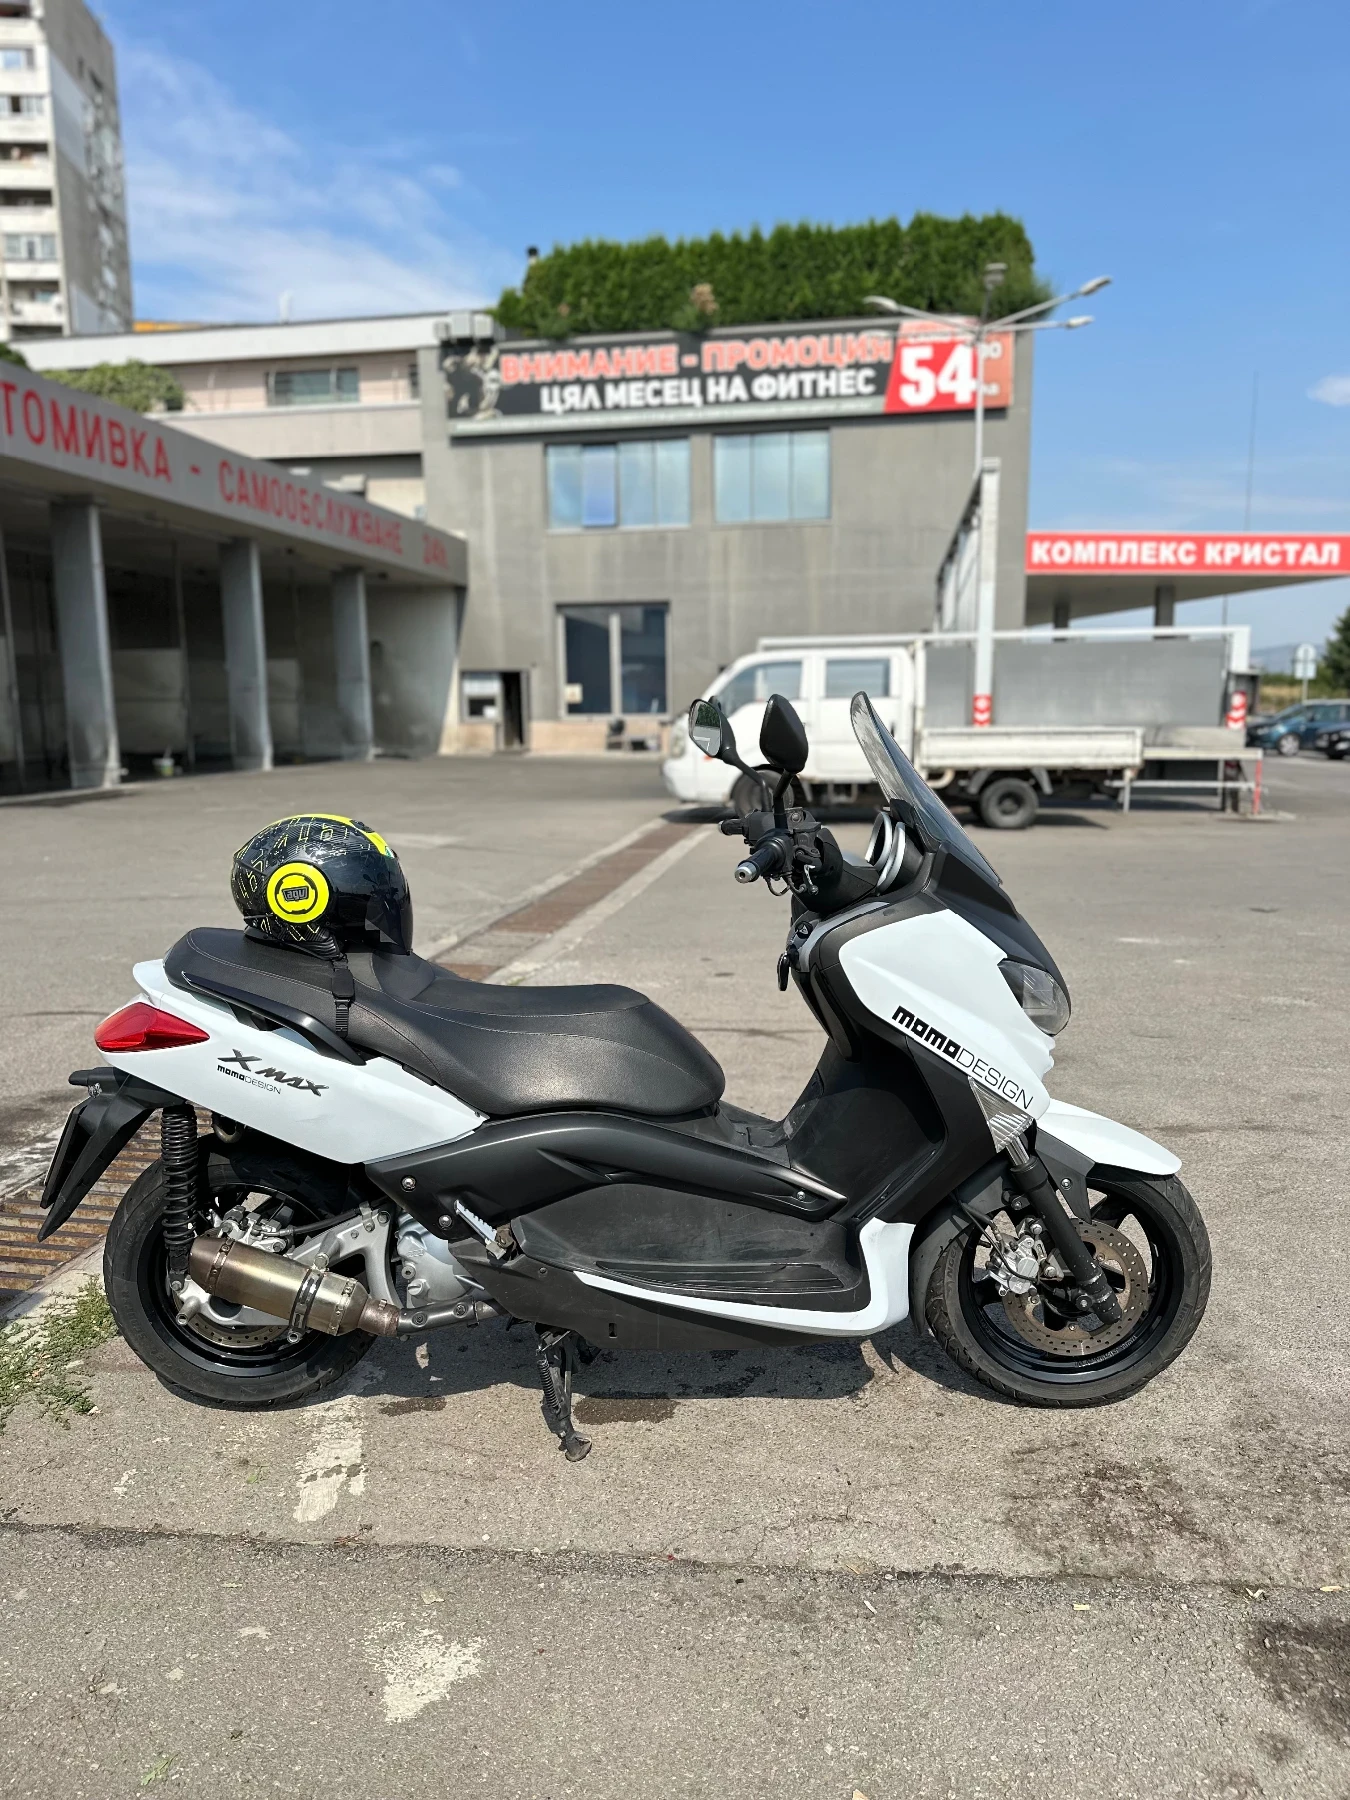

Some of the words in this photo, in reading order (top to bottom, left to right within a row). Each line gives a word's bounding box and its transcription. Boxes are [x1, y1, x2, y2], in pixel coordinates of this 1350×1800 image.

[501, 344, 679, 384] ВНИМАНИЕ
[702, 333, 893, 372] ПРОМОЦИЯ
[899, 343, 977, 407] 54
[540, 383, 601, 415] ЦЯЛ
[603, 377, 704, 409] МЕСЕЦ
[706, 374, 749, 403] НА
[751, 368, 876, 400] ФИТНЕС
[1031, 540, 1197, 565] КОМПЛЕКС
[1204, 541, 1341, 565] КРИСТАЛ
